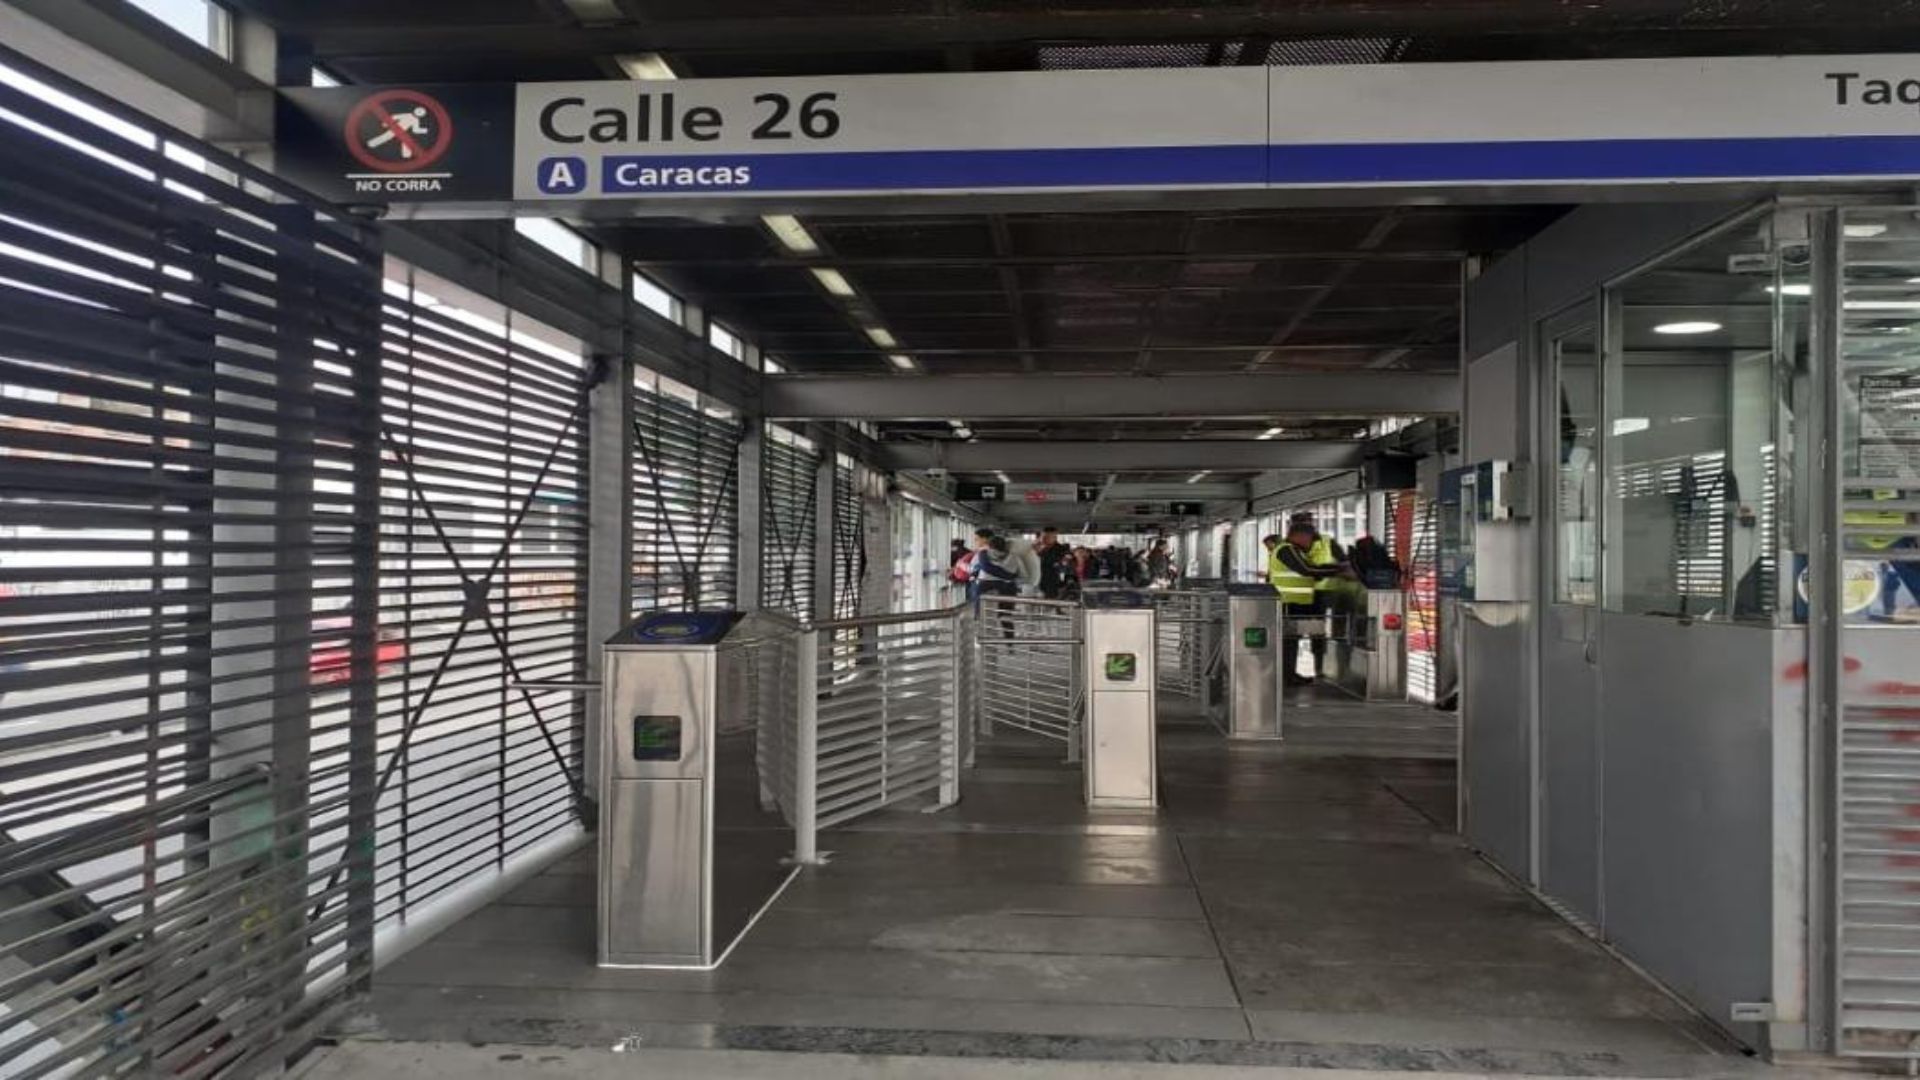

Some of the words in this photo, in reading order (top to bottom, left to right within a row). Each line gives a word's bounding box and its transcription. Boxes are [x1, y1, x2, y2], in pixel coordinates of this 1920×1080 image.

[539, 92, 723, 144] Calle
[751, 91, 840, 140] 26
[355, 180, 382, 192] NO
[385, 179, 442, 192] CORRA
[548, 161, 575, 188] A
[615, 163, 750, 186] Caracas
